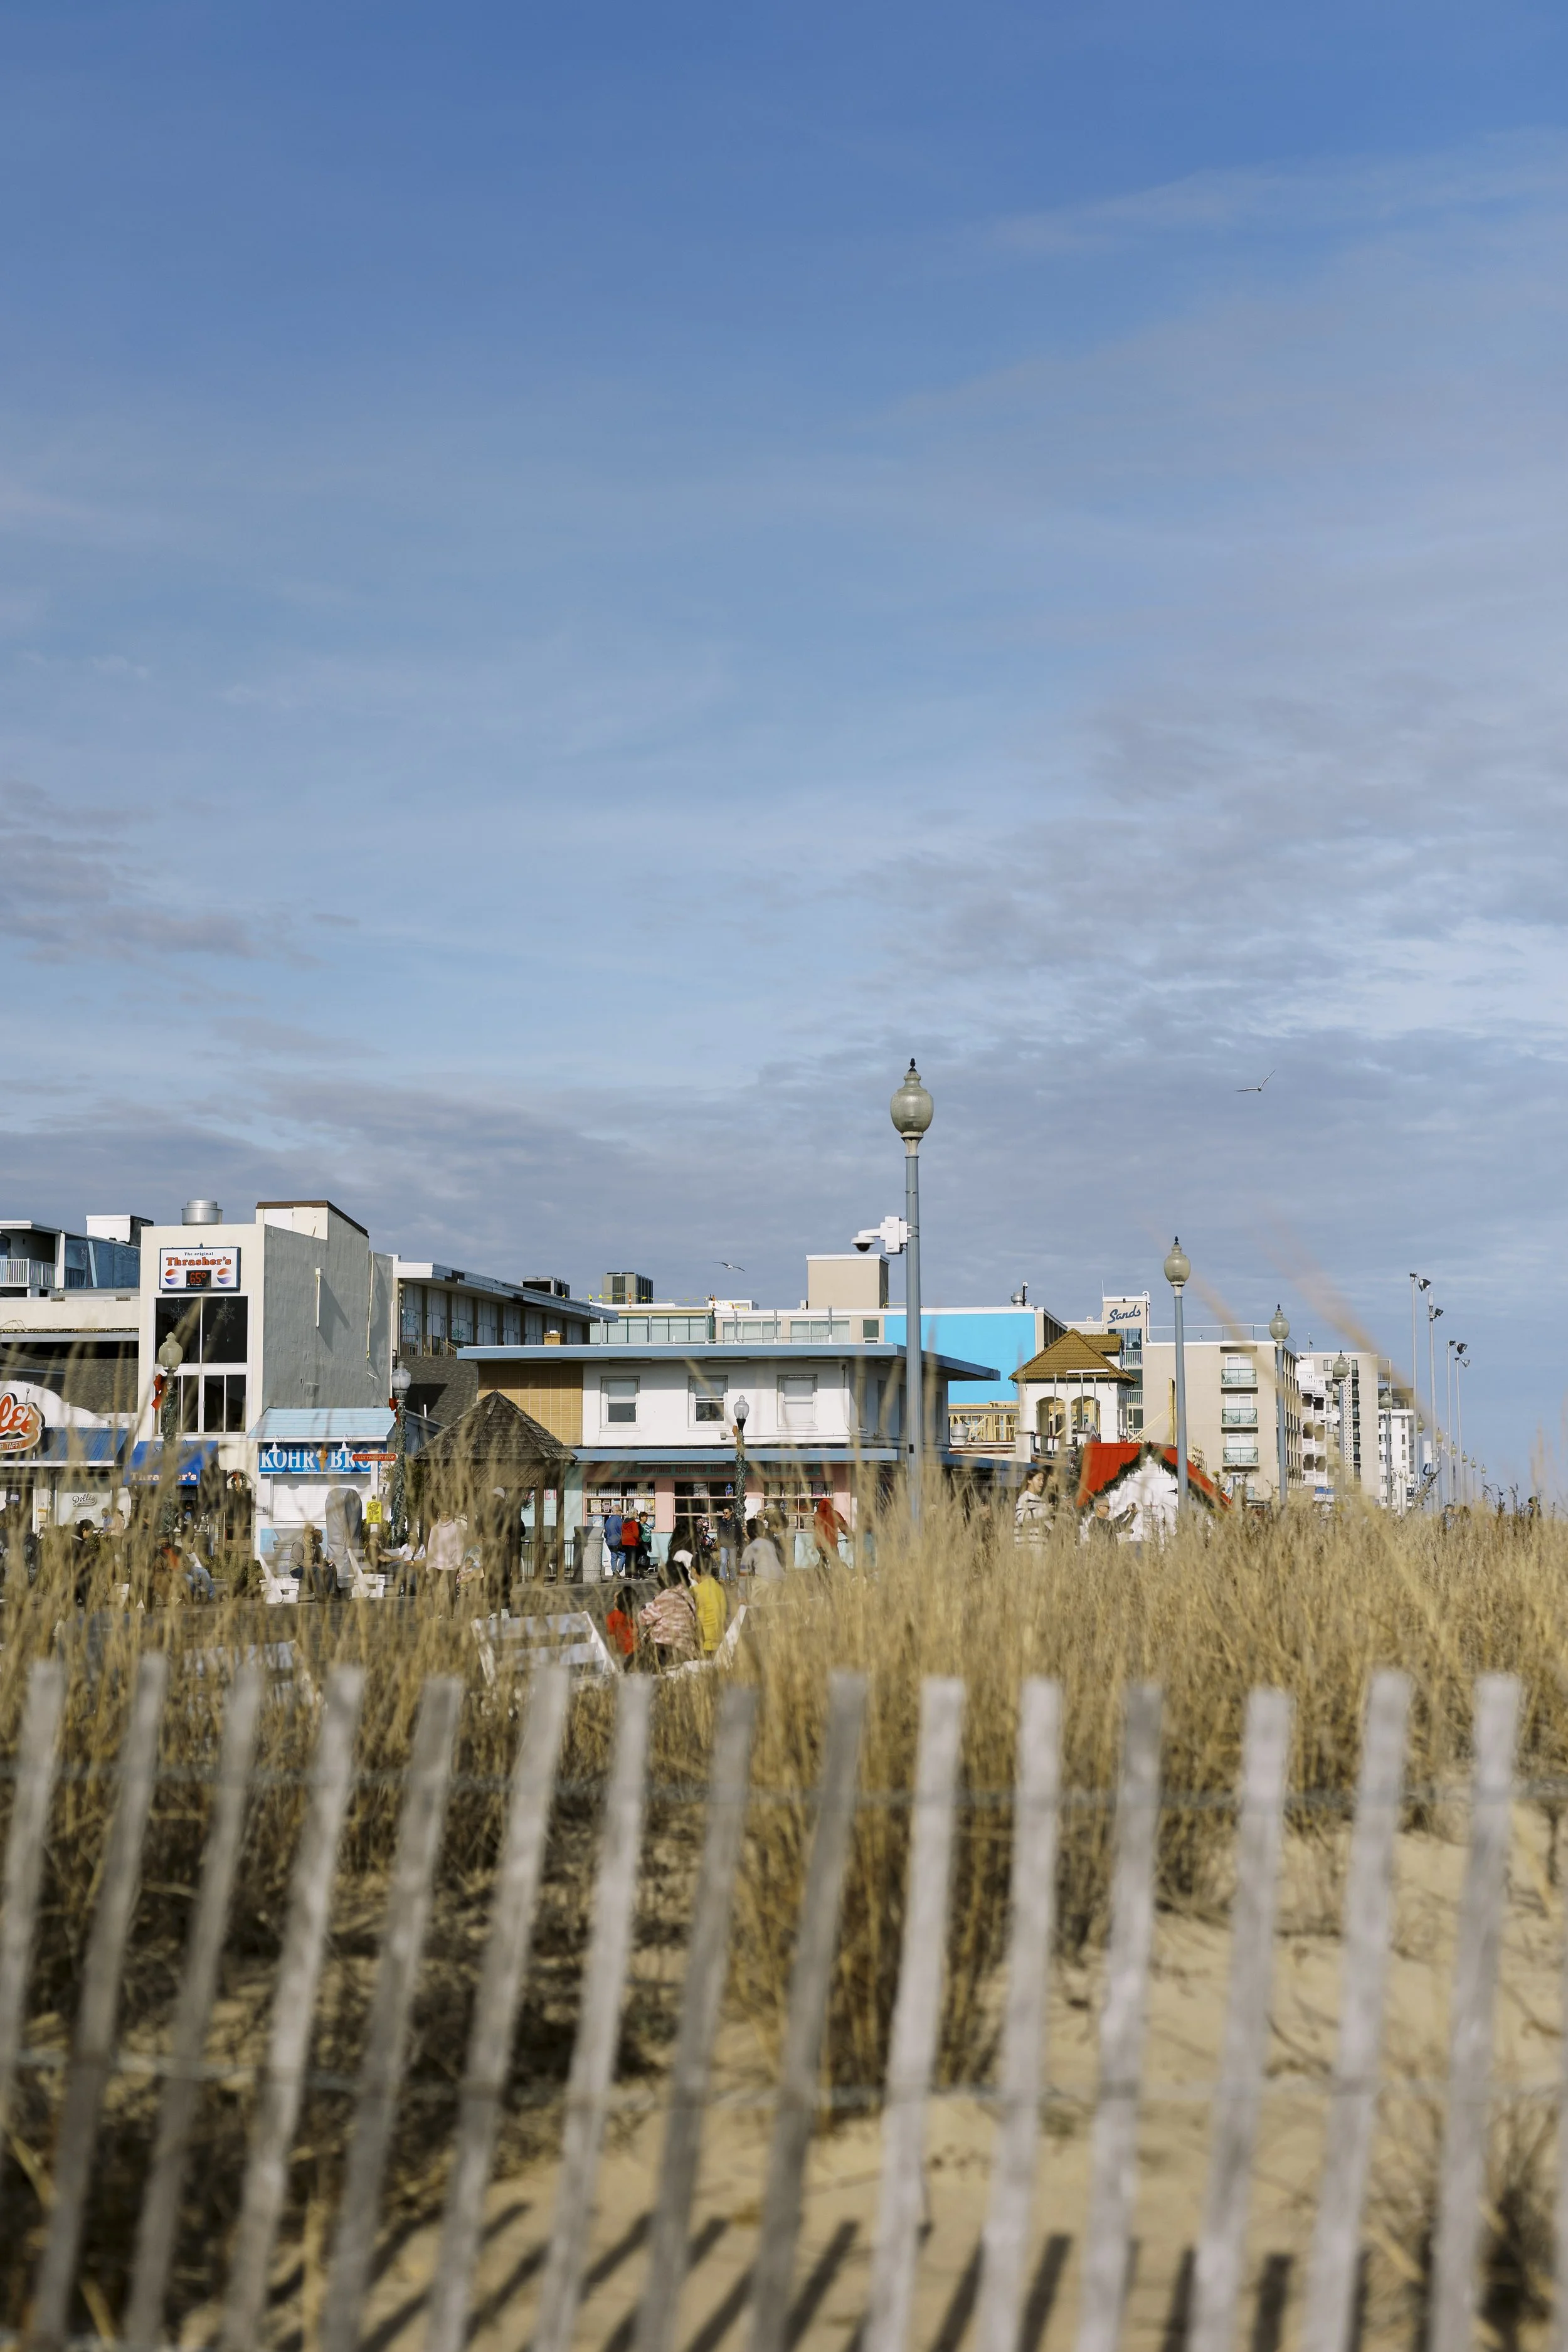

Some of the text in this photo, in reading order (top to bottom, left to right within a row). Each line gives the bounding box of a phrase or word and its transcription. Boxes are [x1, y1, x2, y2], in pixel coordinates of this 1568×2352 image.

[166, 1256, 231, 1266] Thrasher's
[1107, 1305, 1141, 1324] Sands
[260, 1448, 381, 1468] KOHR BRO
